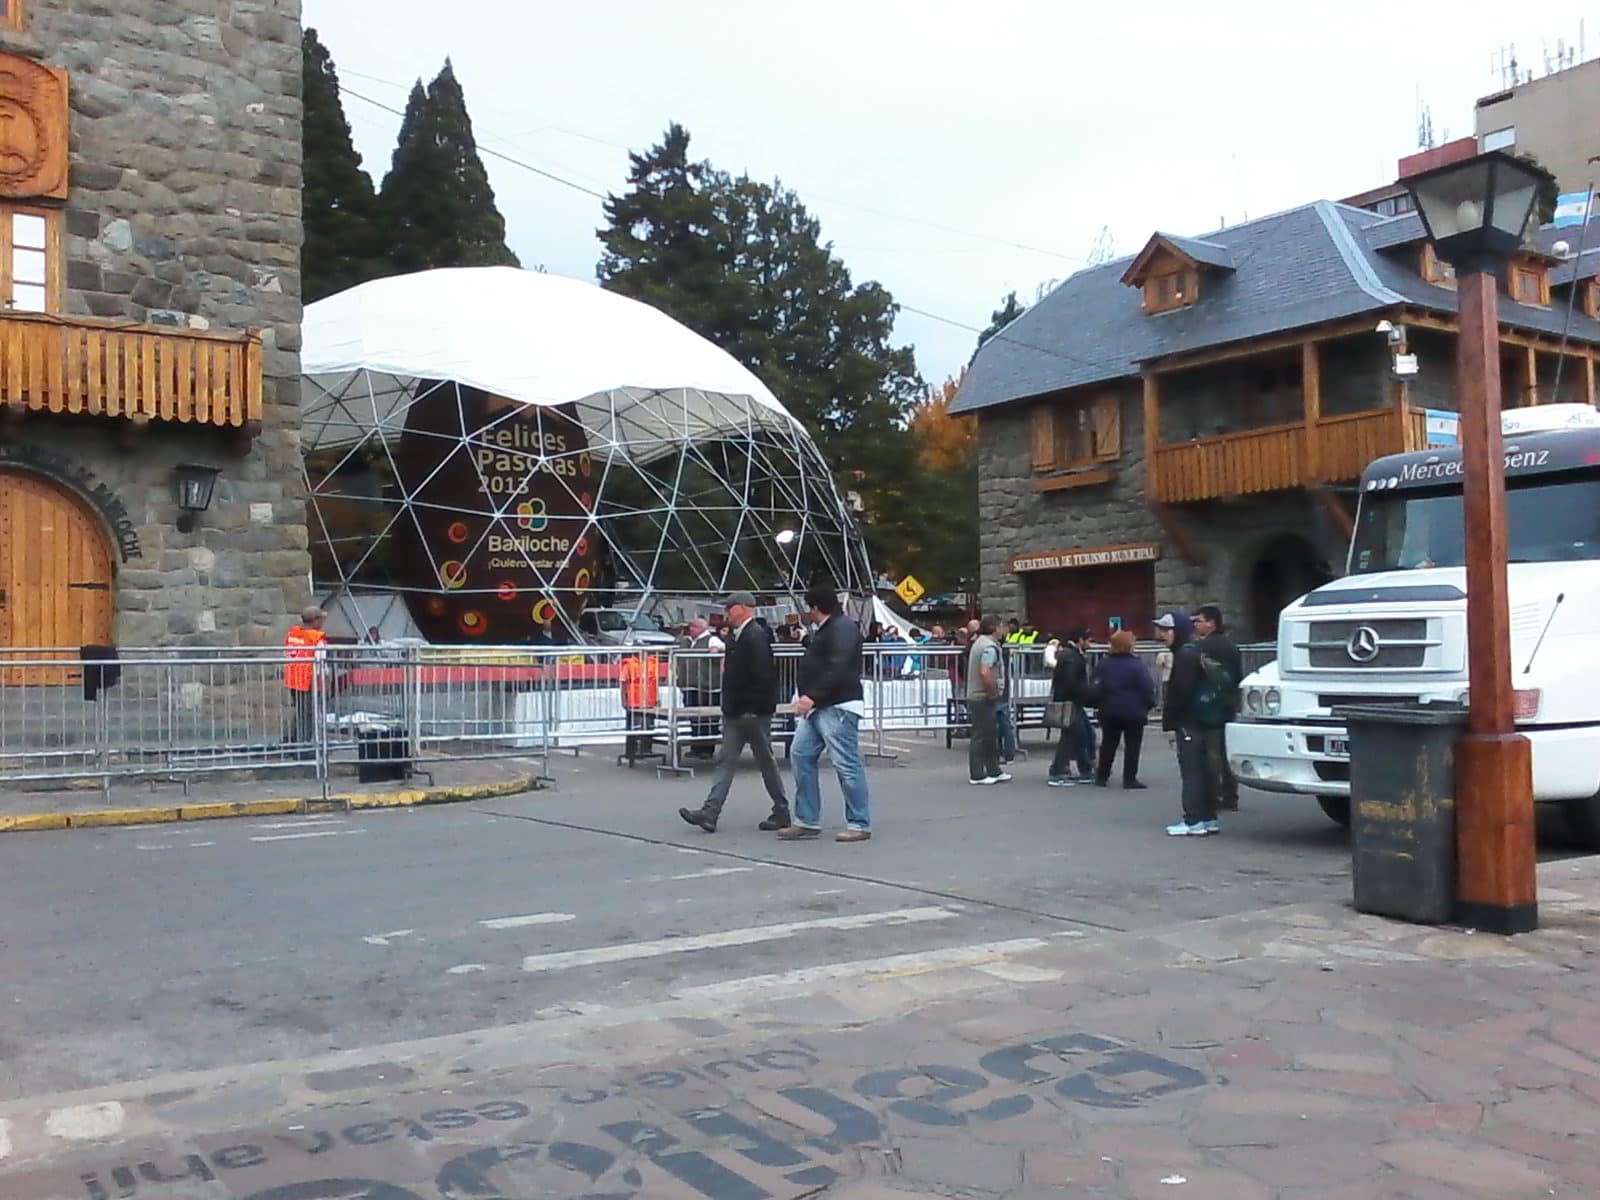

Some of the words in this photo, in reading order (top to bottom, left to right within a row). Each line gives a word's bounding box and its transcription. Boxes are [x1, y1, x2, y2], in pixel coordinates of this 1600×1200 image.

[481, 423, 566, 451] Felices
[478, 475, 530, 495] 2013
[488, 535, 570, 552] Bariloche
